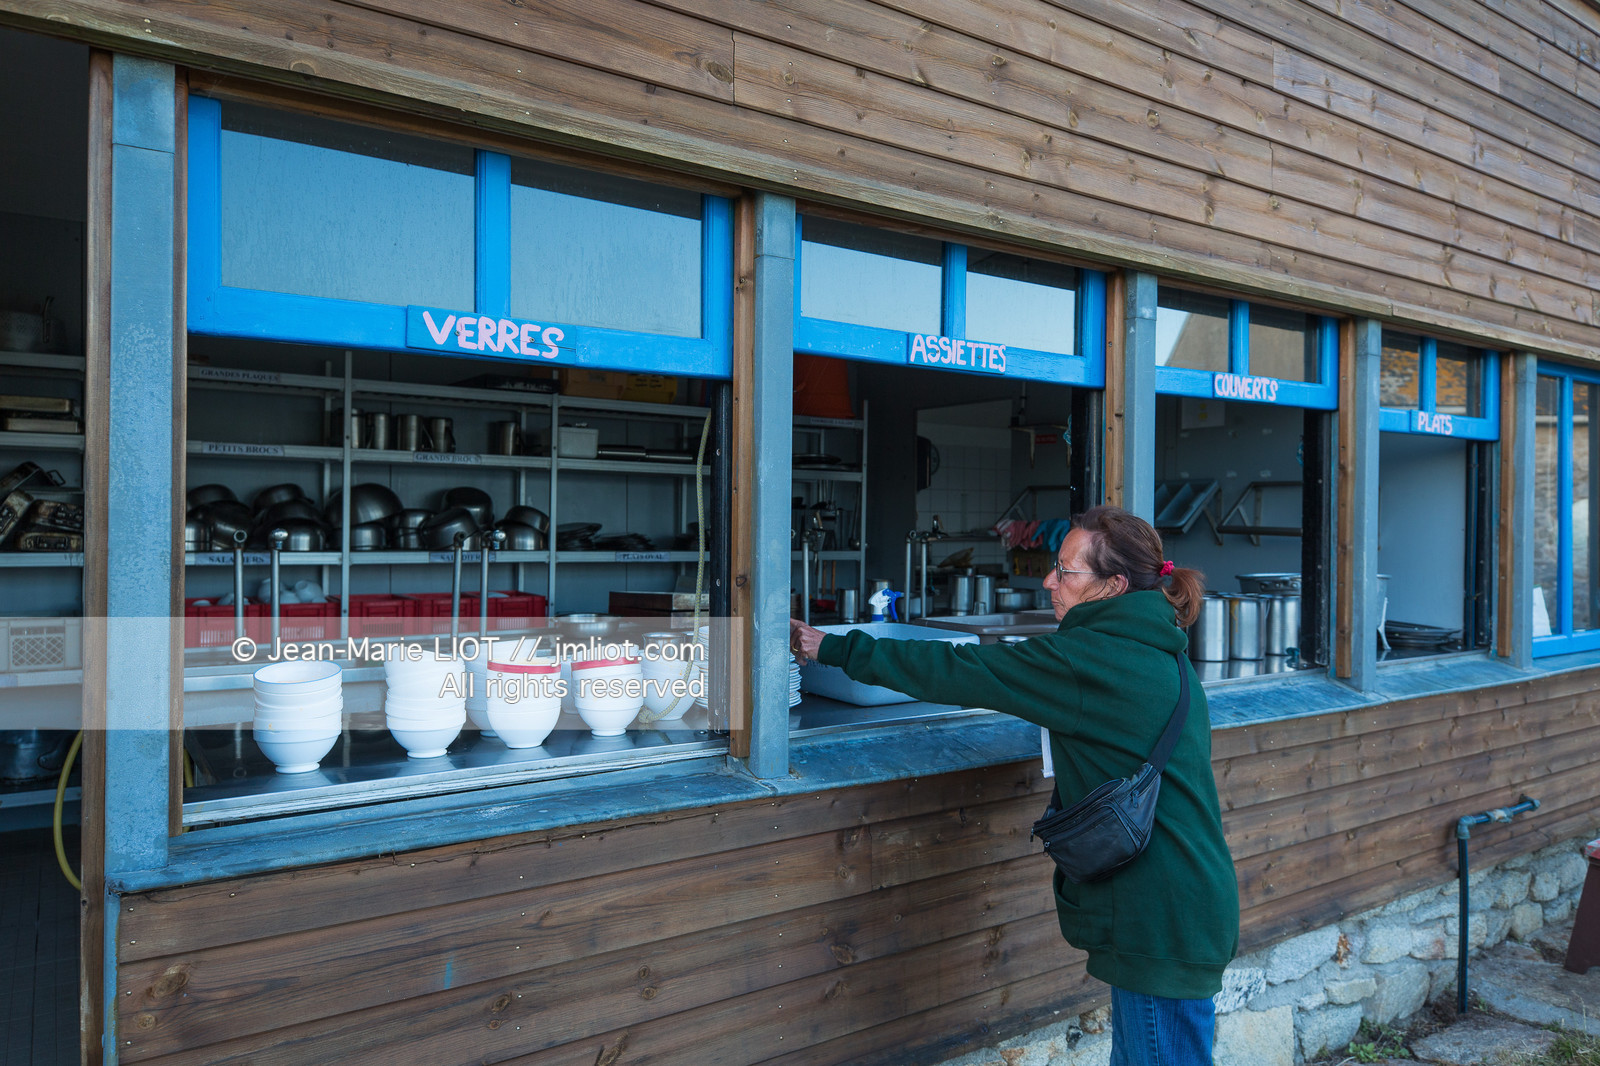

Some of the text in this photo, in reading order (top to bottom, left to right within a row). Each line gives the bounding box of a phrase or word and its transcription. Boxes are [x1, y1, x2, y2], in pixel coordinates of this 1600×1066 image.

[422, 311, 565, 359] VERRES
[910, 334, 1006, 372] ASSIETTES
[201, 369, 279, 381] GRANDES PLAQUES
[1214, 374, 1278, 401] COUVERTS
[1418, 411, 1452, 435] PLATS
[208, 444, 279, 454] PETITS BROCS
[415, 453, 450, 461] GRANDS
